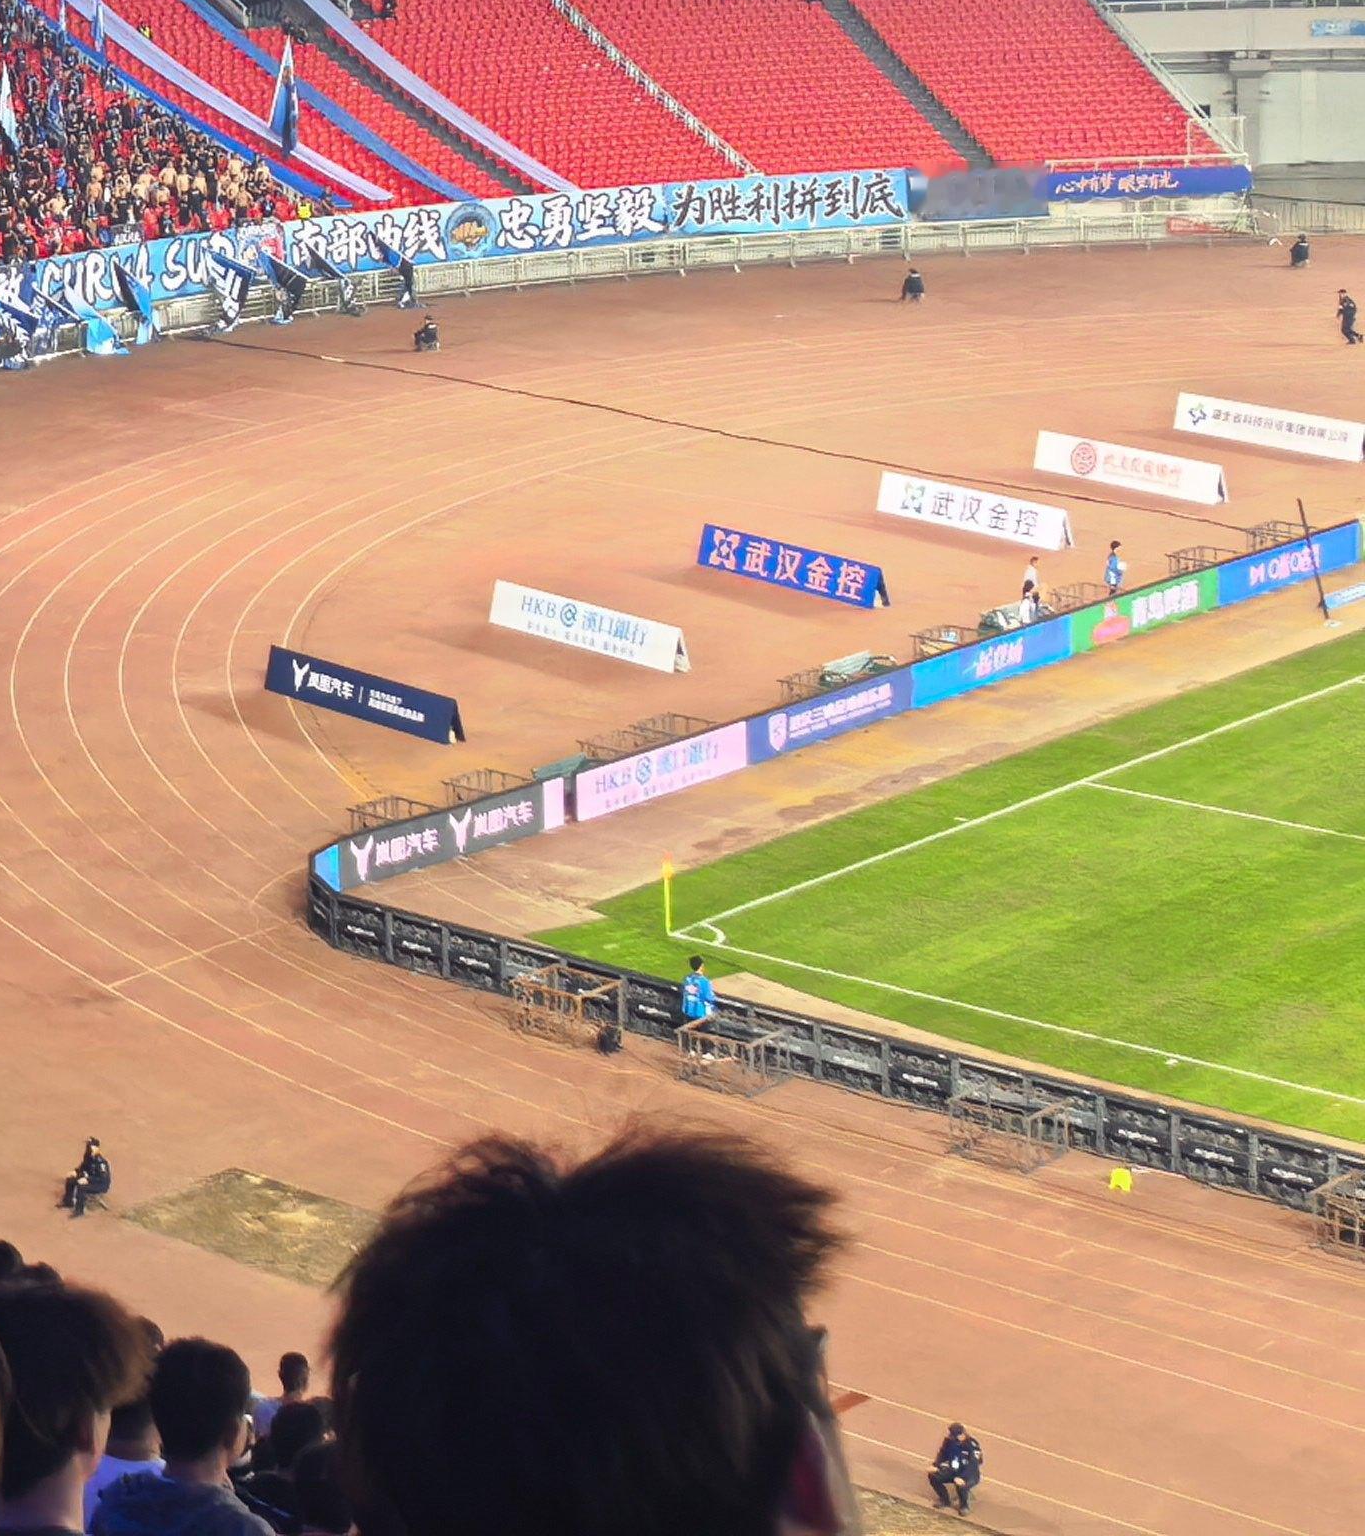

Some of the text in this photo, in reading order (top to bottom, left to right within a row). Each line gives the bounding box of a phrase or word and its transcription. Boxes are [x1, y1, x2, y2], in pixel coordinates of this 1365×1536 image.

[494, 186, 667, 252] 忠勇坚毅
[672, 172, 905, 229] 为胜利拼到底
[931, 491, 1040, 537] 武汉金控
[742, 540, 868, 601] 武汉金控
